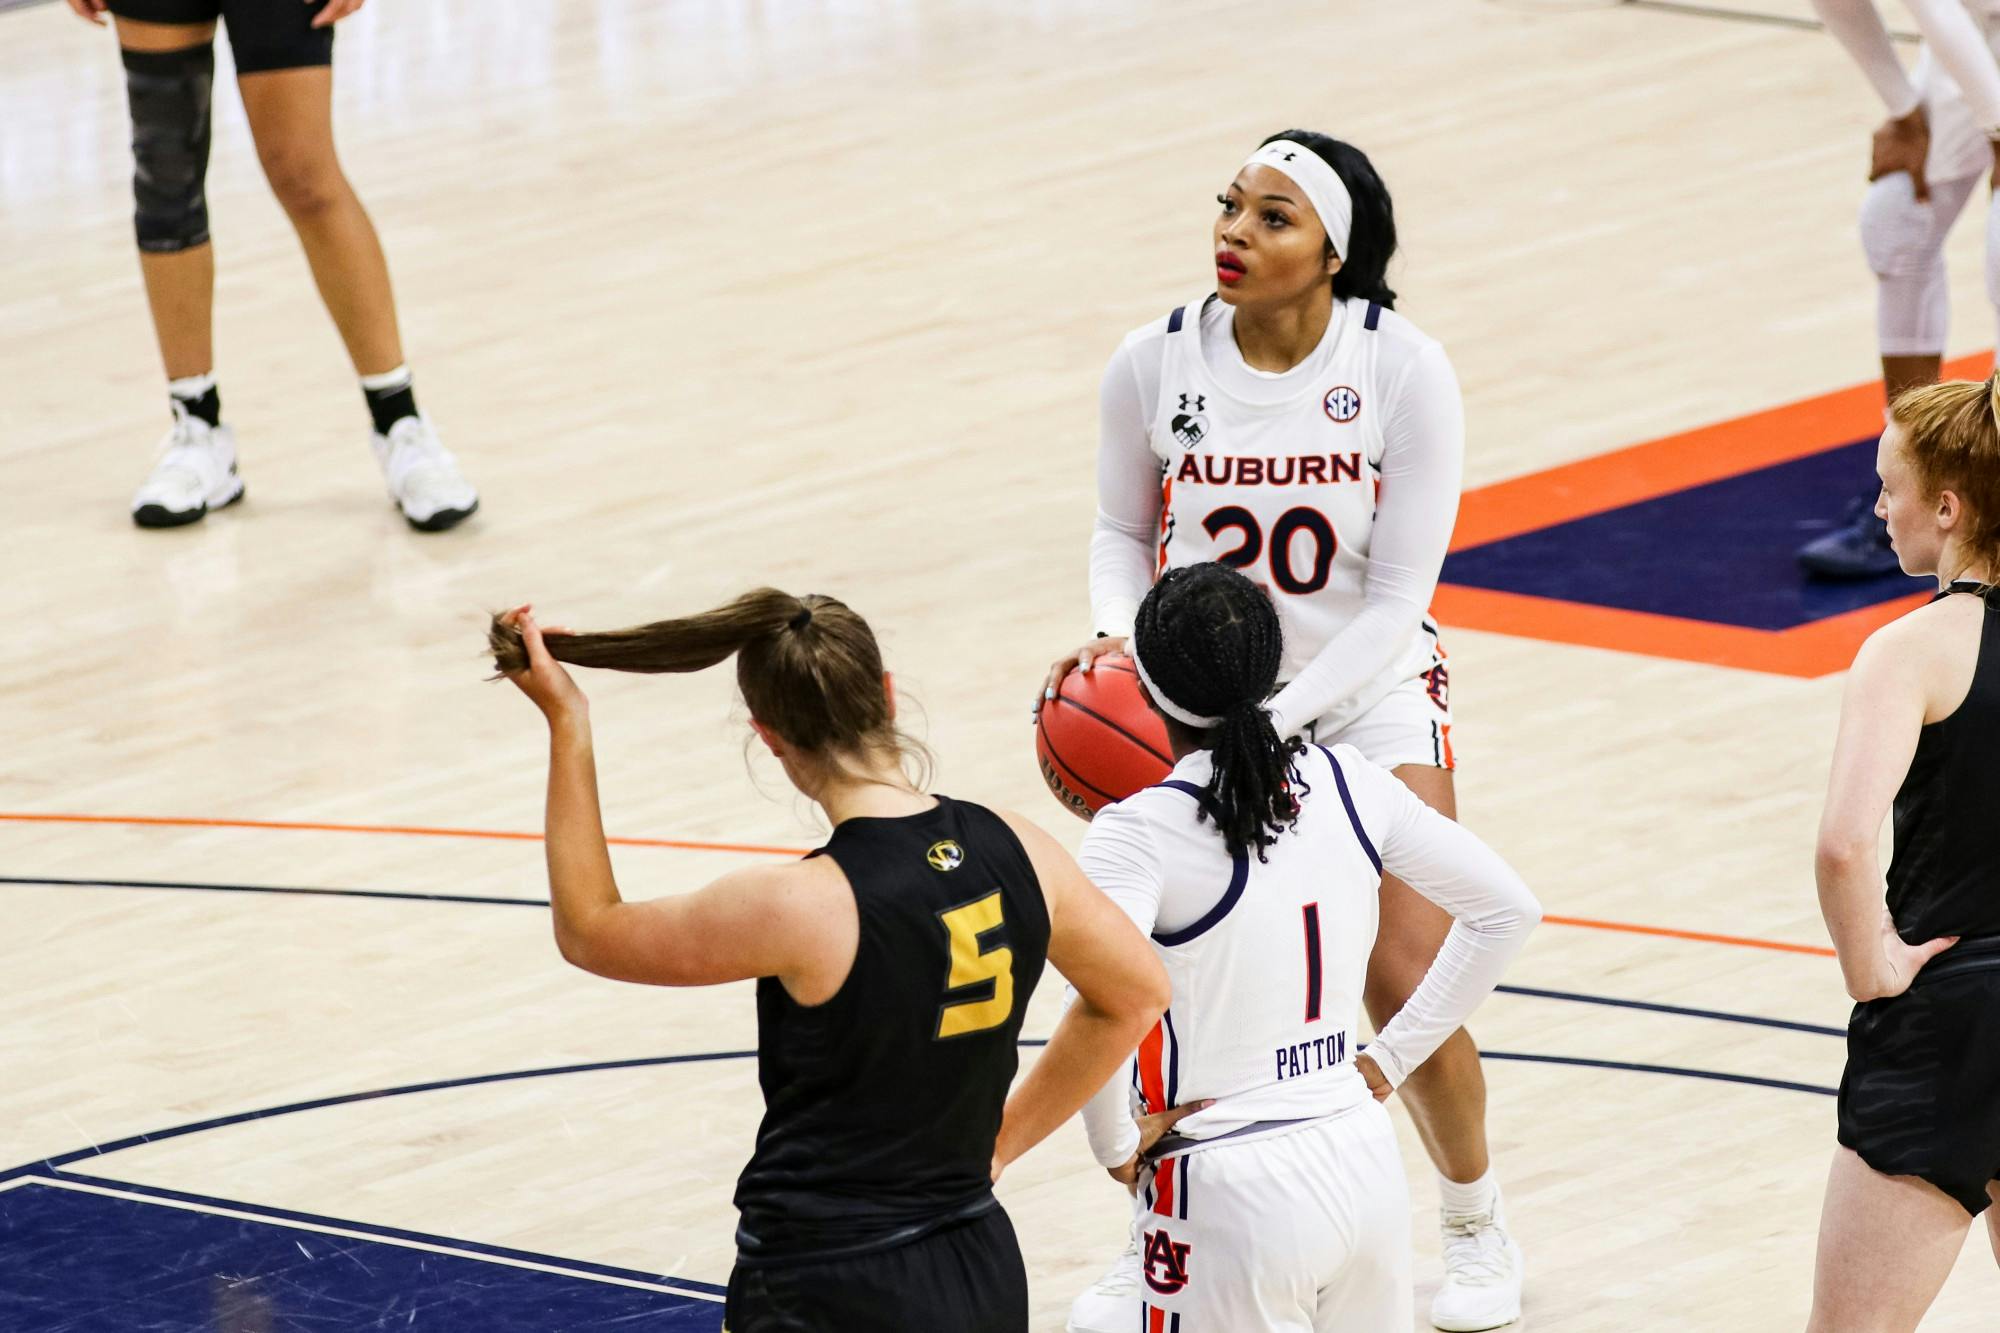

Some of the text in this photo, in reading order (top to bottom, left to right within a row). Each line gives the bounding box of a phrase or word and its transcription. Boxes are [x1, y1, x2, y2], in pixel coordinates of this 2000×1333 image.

[1176, 453, 1361, 486] AUBURN
[1201, 505, 1338, 595] 20
[932, 887, 1014, 1041] 5
[1302, 901, 1323, 1024] 1
[1276, 1030, 1345, 1080] PATTON
